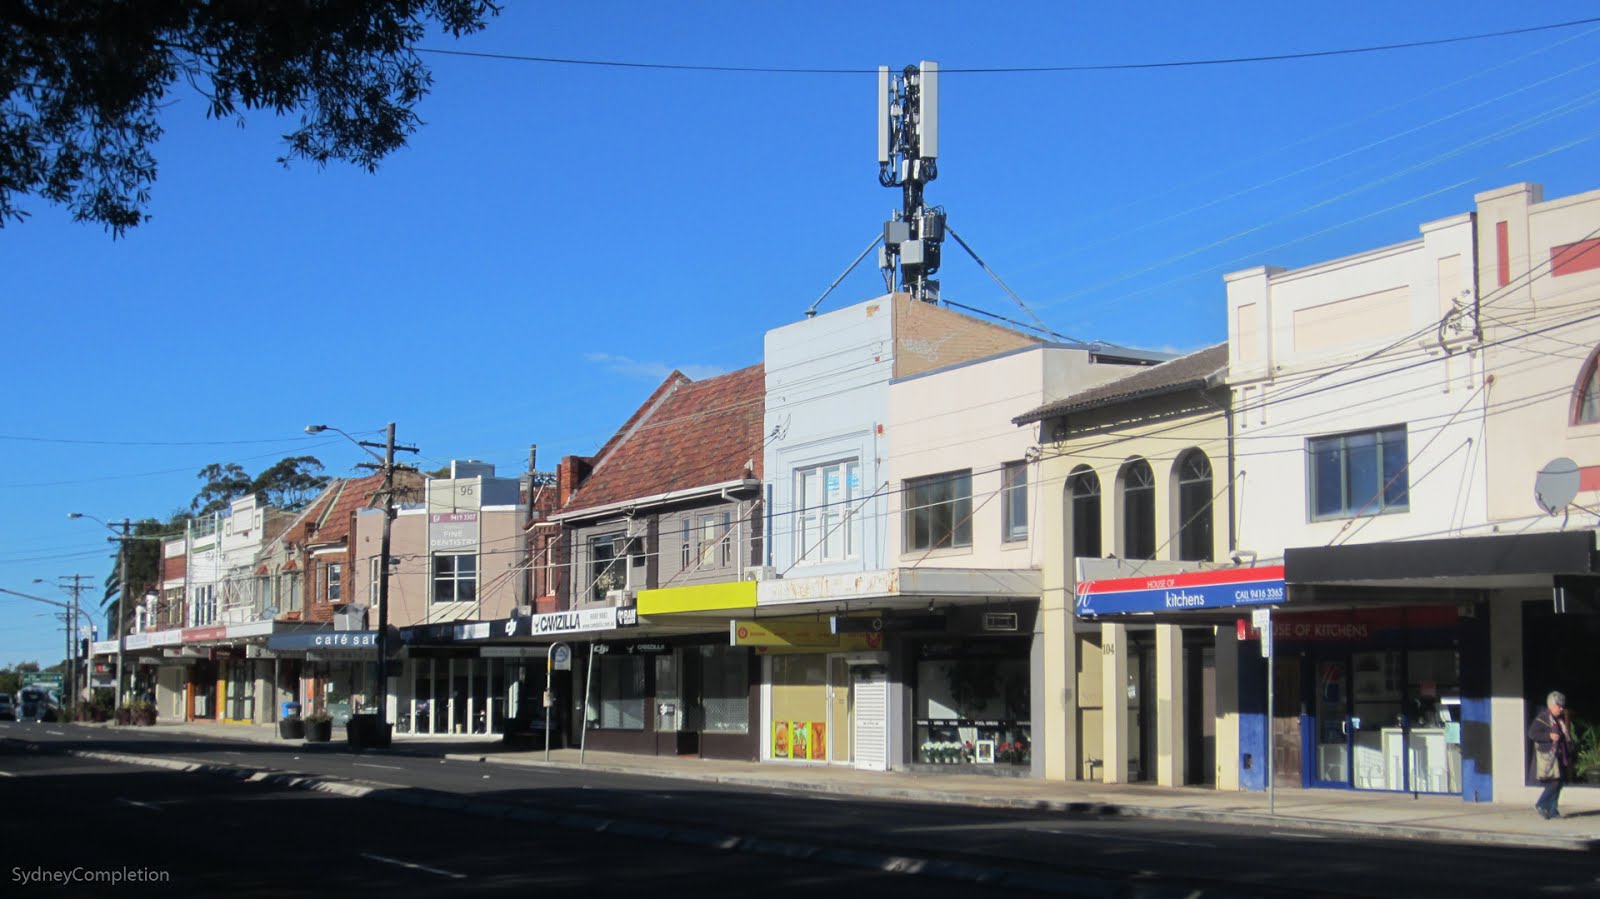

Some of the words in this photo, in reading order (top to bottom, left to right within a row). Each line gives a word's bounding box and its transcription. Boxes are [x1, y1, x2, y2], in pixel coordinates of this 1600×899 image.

[460, 485, 473, 496] 96
[431, 538, 477, 546] DENTISTRY
[1147, 580, 1166, 589] HOUSE
[1167, 579, 1175, 587] OF
[1165, 590, 1205, 607] kitchens
[1235, 591, 1249, 600] CALL
[1250, 589, 1266, 598] 9416
[1267, 588, 1283, 597] 3365
[1295, 624, 1312, 636] OF
[1315, 623, 1367, 637] KITCHENS
[315, 633, 348, 645] café
[1102, 644, 1115, 655] 104
